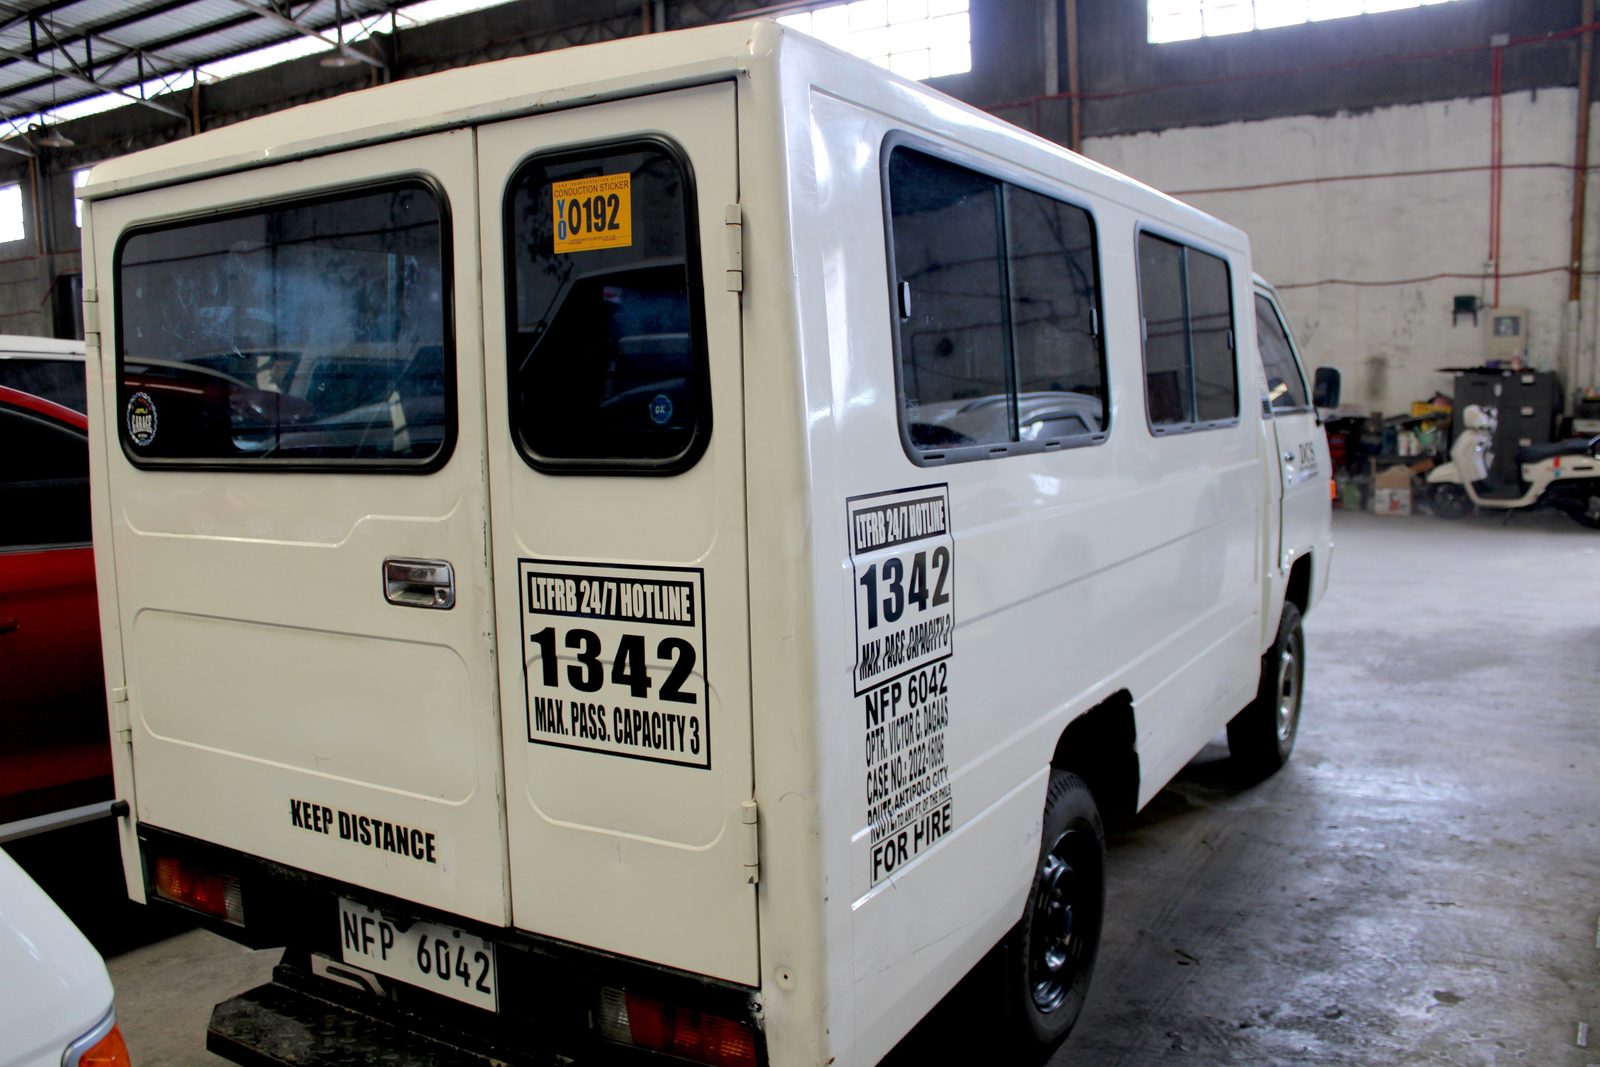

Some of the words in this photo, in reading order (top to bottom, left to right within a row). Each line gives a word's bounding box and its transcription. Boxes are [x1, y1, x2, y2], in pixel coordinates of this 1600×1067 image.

[554, 184, 598, 198] CONDUCTION
[599, 179, 629, 192] STICKER
[568, 193, 620, 235] 0192
[856, 510, 886, 549] LTFRB
[886, 506, 908, 543] 24/7
[908, 500, 946, 539] HOTLINE
[531, 576, 577, 613] LTFRB
[579, 579, 617, 616] 24/7
[619, 582, 692, 622] HOTLINE
[860, 545, 950, 630] 1342
[530, 626, 698, 705] 1342
[859, 638, 881, 681] MAX.
[882, 629, 906, 673] PASS.
[906, 618, 946, 663] CAPACITY
[534, 695, 568, 736] MAX.
[570, 701, 611, 742] PASS.
[613, 706, 686, 752] CAPACITY
[689, 716, 700, 755] 3
[865, 681, 902, 730] NFP
[908, 661, 948, 709] 6042
[865, 726, 888, 768] OPTR.
[888, 712, 914, 756] VICTOR
[866, 762, 889, 806] CASE
[895, 775, 931, 813] ANTIPOLO
[932, 765, 949, 788] CITY
[290, 798, 333, 835] KEEP
[337, 810, 437, 864] DISTANCE
[873, 830, 908, 883] FOR
[914, 803, 951, 854] HIRE
[343, 910, 394, 961] NFP
[417, 934, 491, 995] 6042
